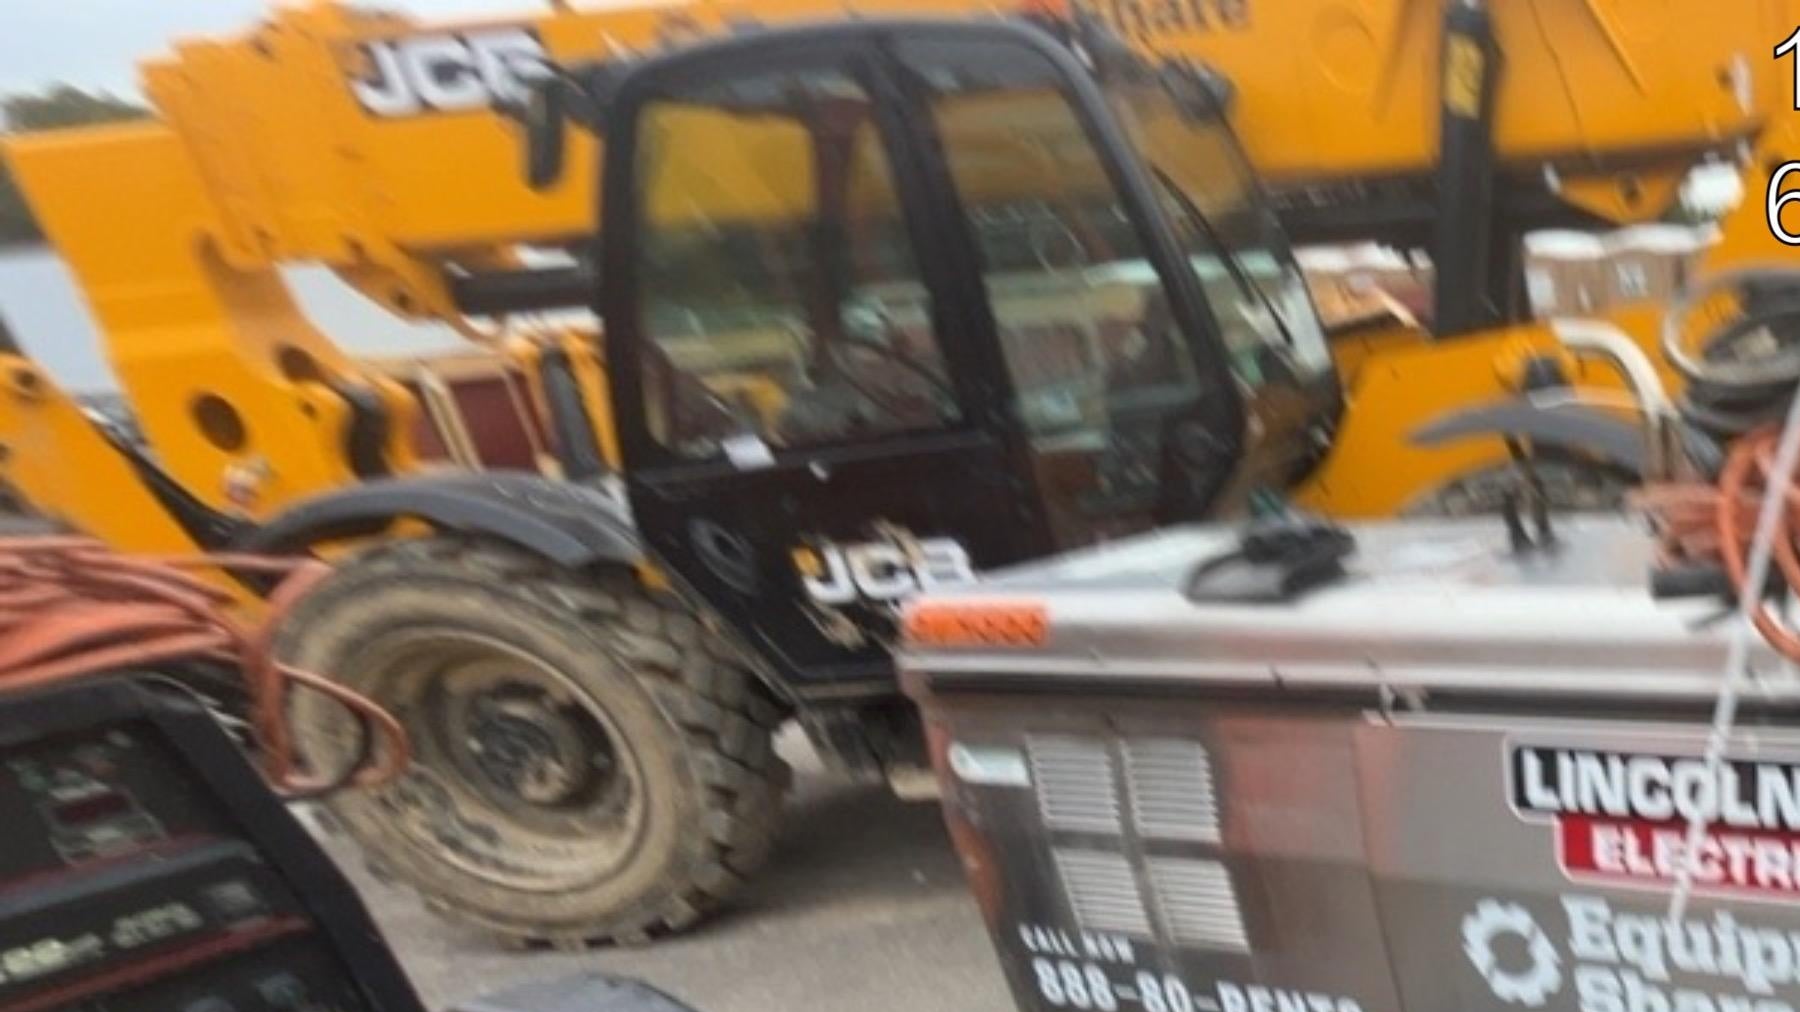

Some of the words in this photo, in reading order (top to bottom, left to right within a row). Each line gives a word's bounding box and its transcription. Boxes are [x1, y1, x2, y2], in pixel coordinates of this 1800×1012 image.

[1092, 0, 1252, 32] hare
[803, 537, 980, 603] JCB
[1019, 922, 1080, 957] CALL
[1080, 929, 1135, 963] NOW
